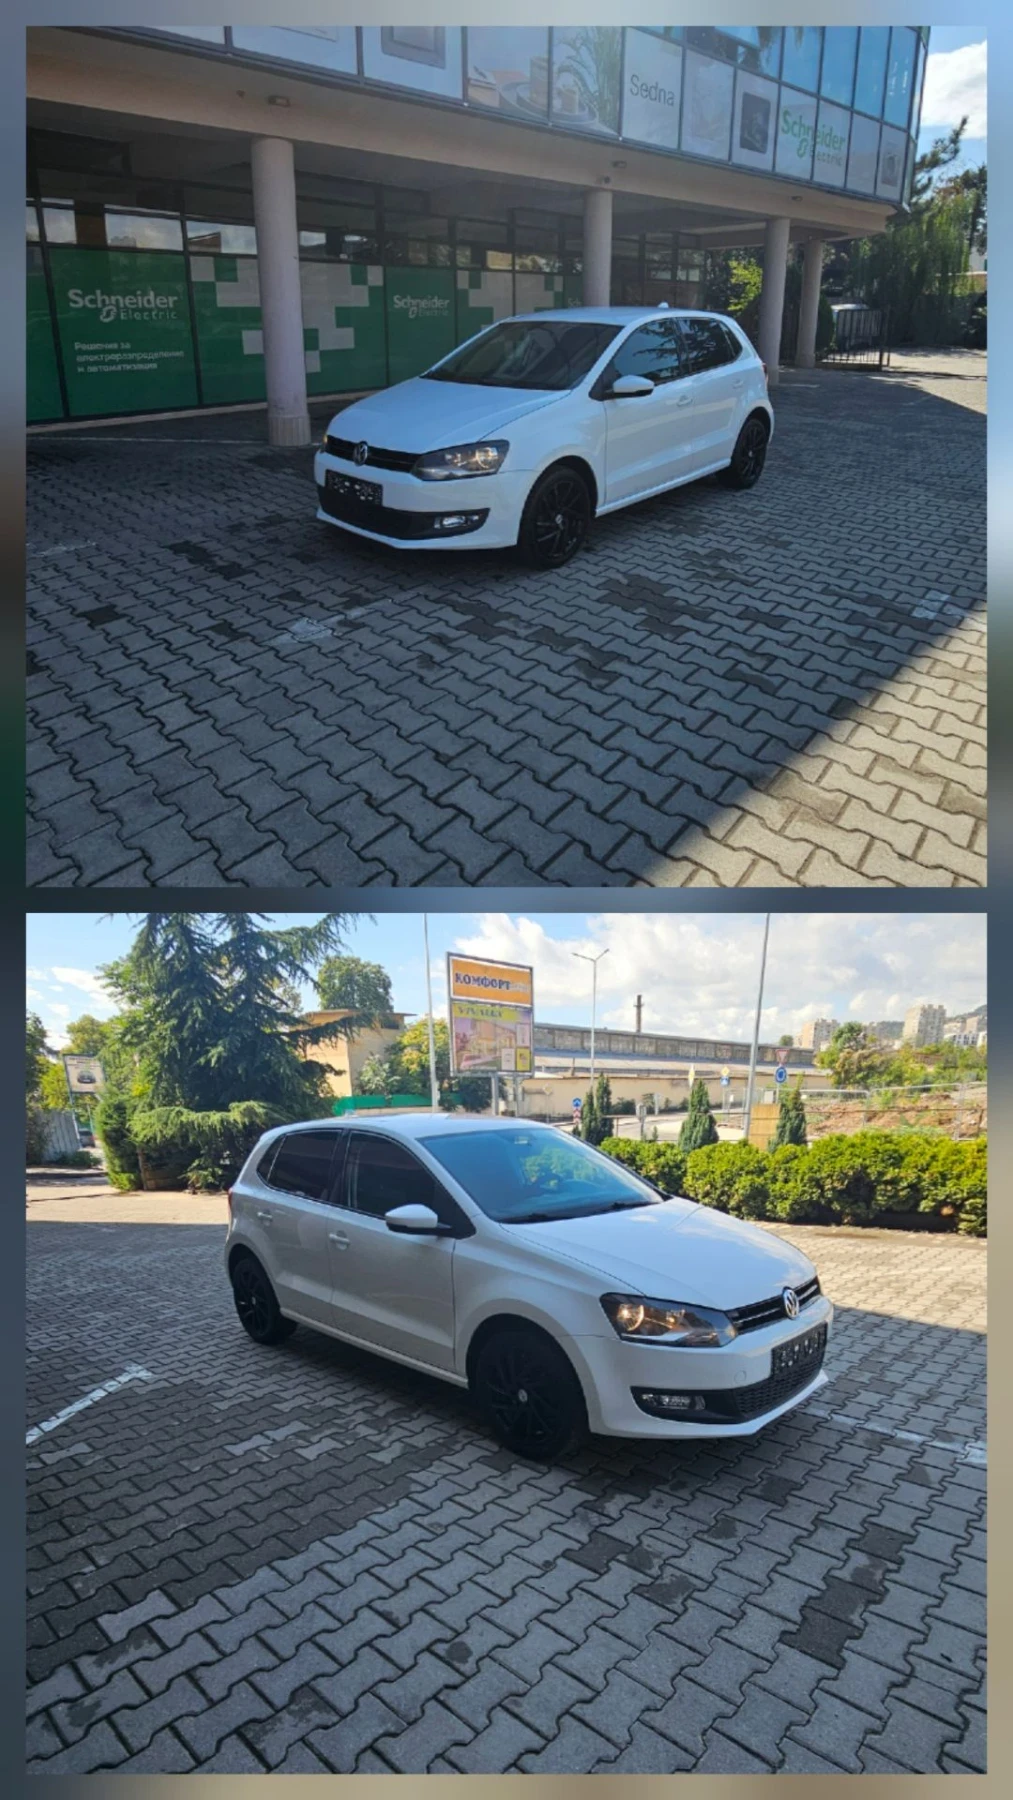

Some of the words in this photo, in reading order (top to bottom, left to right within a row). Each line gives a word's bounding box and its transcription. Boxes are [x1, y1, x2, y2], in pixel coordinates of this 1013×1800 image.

[630, 74, 675, 107] Sedna
[781, 109, 846, 151] Schneider
[68, 287, 179, 309] Schneider
[393, 294, 450, 309] Schneider
[119, 307, 178, 321] Electric
[454, 971, 512, 991] КОМФОРТ
